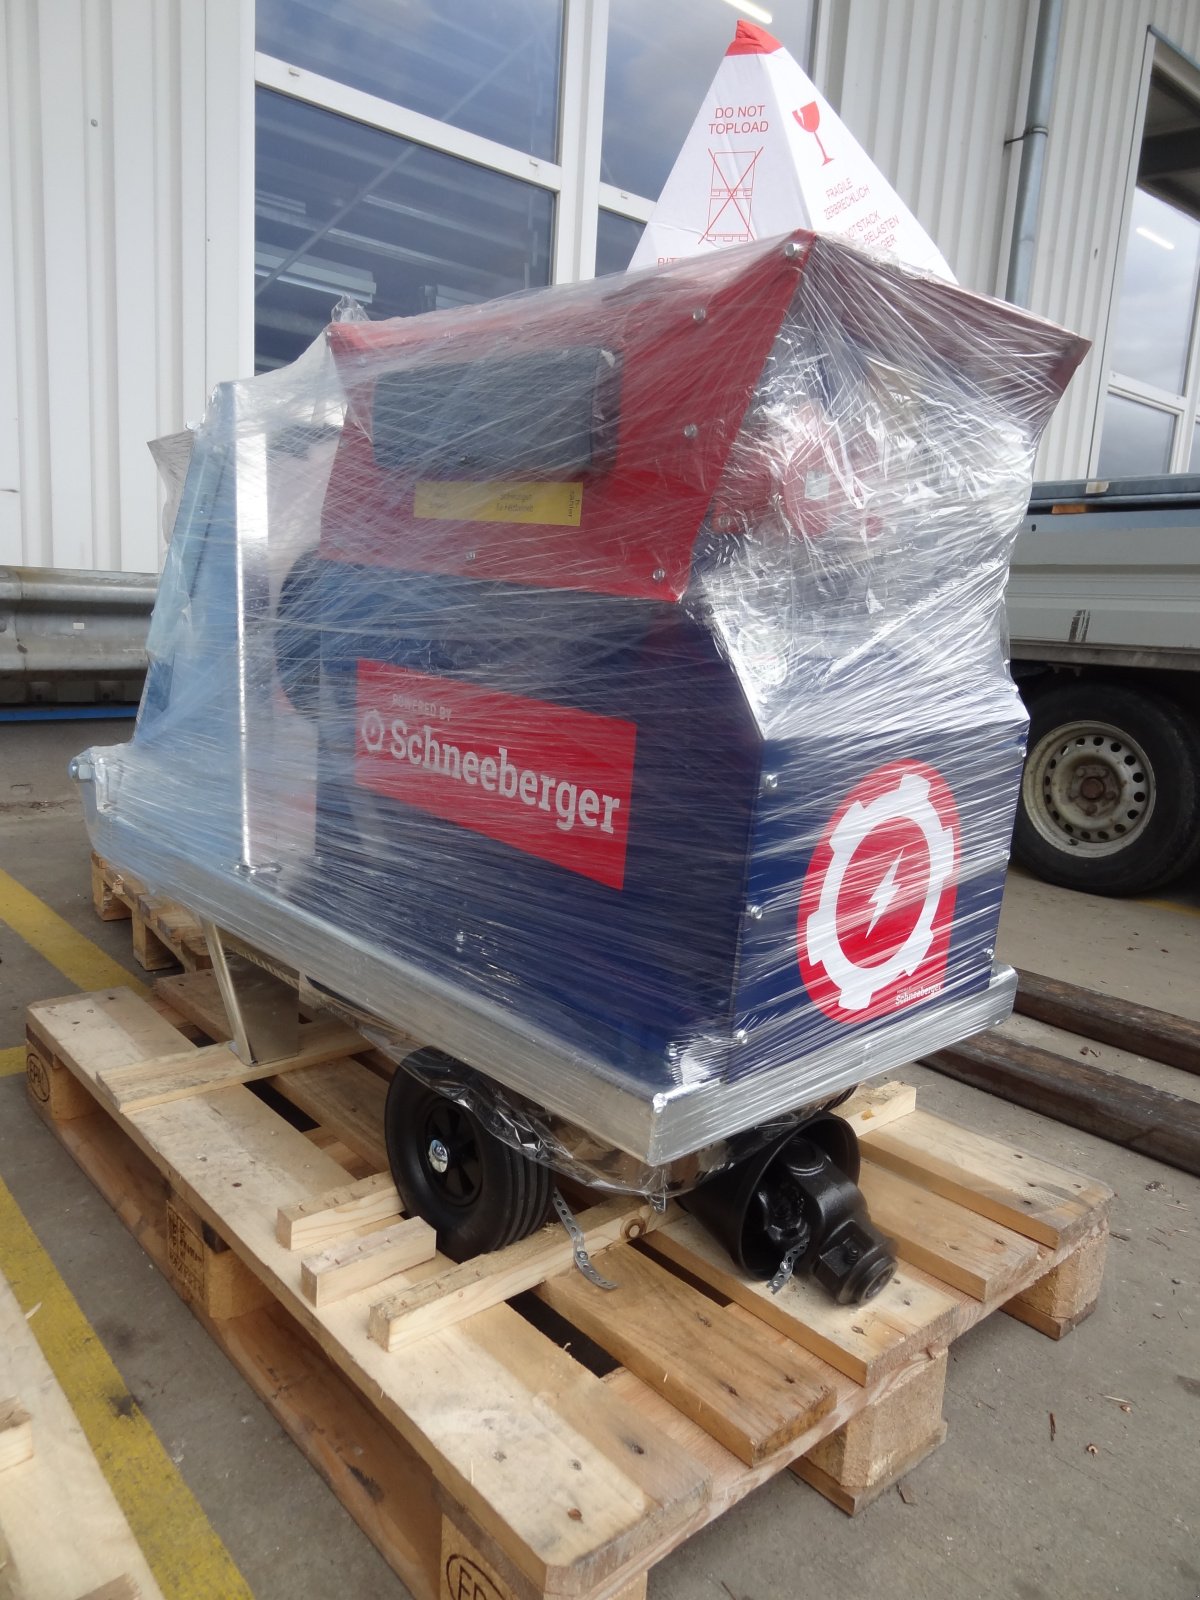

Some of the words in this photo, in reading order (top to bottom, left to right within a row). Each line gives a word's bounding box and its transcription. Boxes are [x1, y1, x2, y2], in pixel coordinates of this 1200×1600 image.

[715, 107, 734, 119] DO
[737, 104, 766, 118] NOT
[708, 120, 769, 135] TOPLOAD
[825, 177, 853, 200] FRAGILE
[824, 184, 870, 220] ZERBRECHLICH
[856, 209, 881, 232] STACK
[392, 693, 437, 717] POWERED
[439, 706, 452, 722] BY
[390, 718, 620, 834] Schneeberger
[895, 982, 942, 1006] Schneeberger
